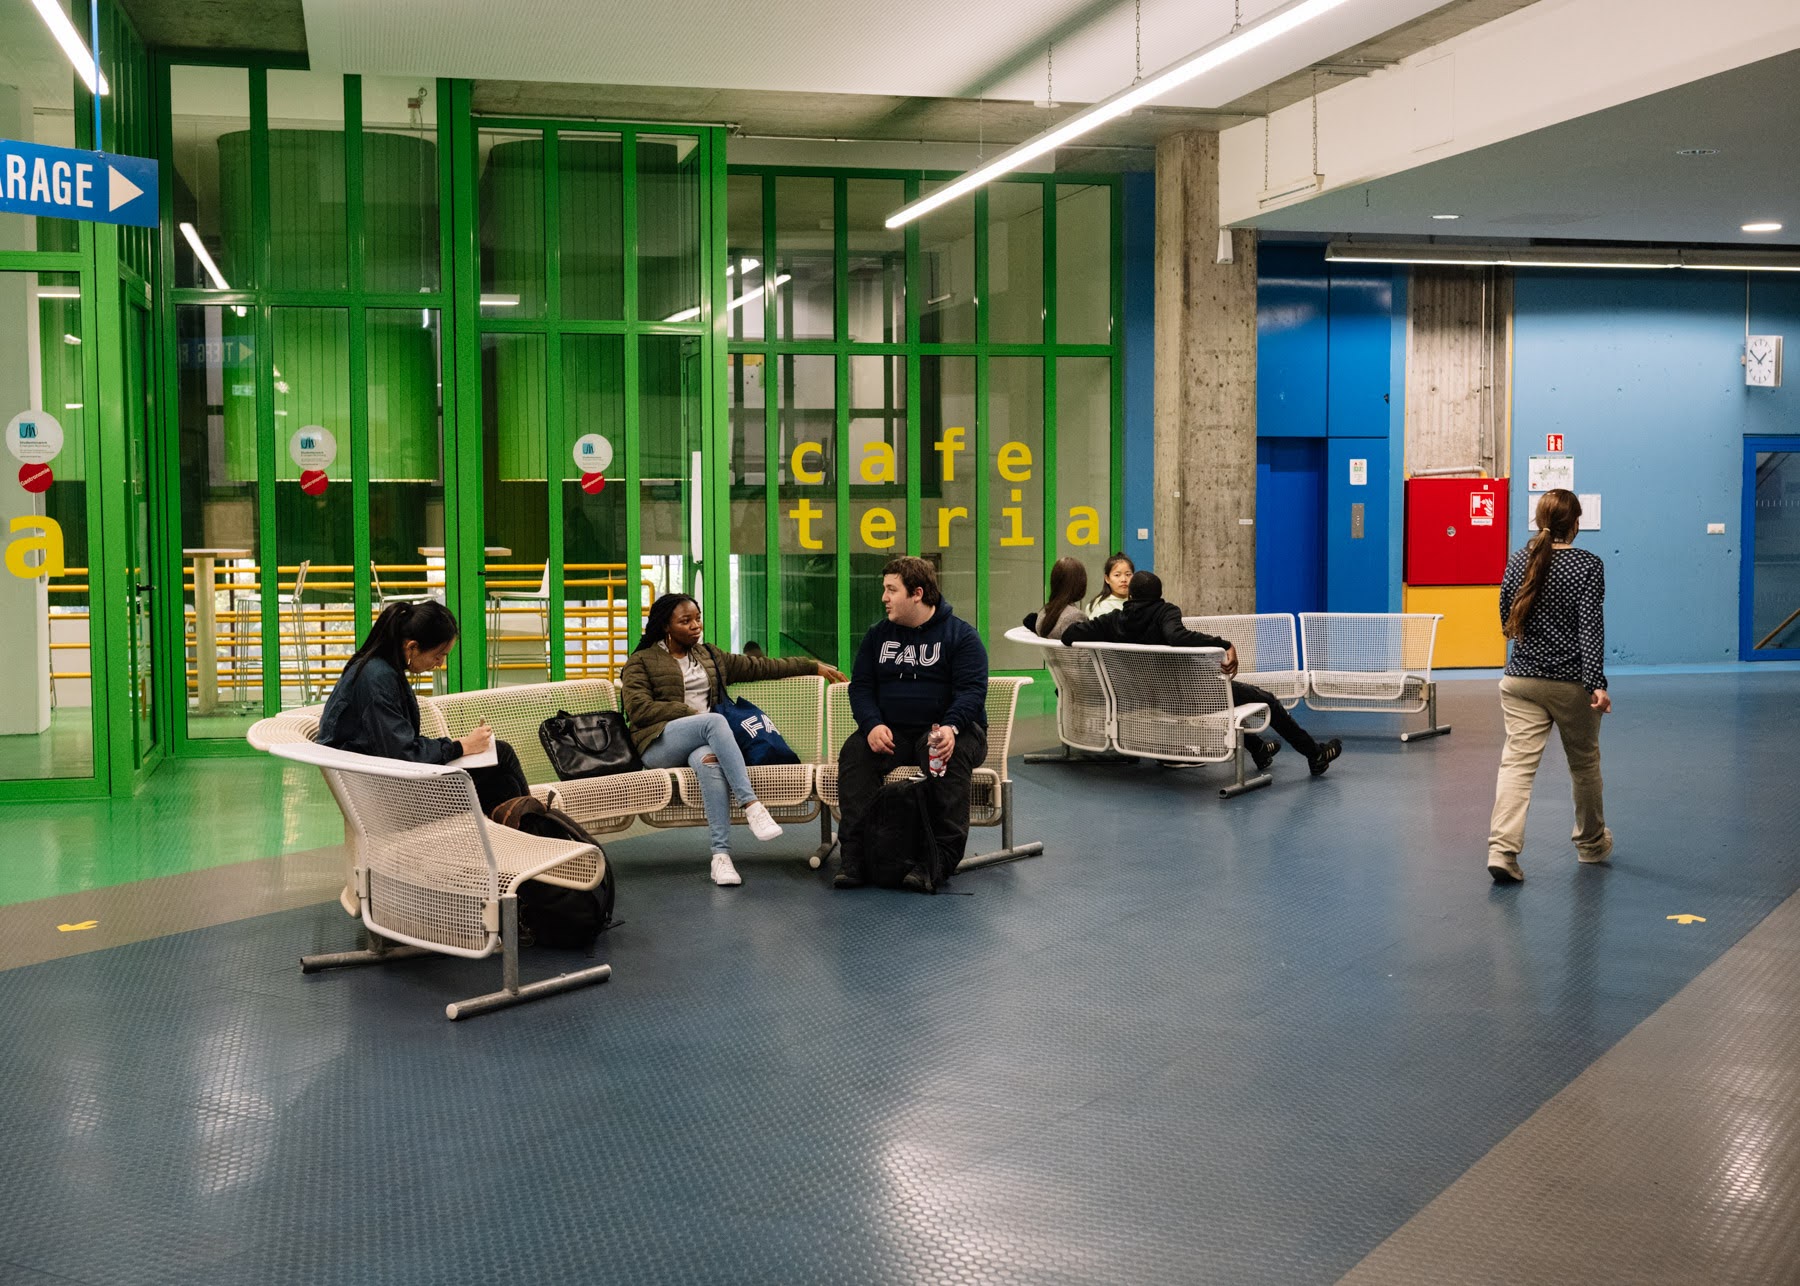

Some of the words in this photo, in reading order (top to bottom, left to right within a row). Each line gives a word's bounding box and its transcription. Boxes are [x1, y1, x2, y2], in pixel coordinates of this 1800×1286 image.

[0, 154, 93, 208] RAGE
[20, 467, 51, 487] Gastronomie
[791, 427, 1032, 482] cafe
[789, 489, 1100, 549] teria
[4, 515, 64, 579] a
[879, 641, 941, 667] FAU
